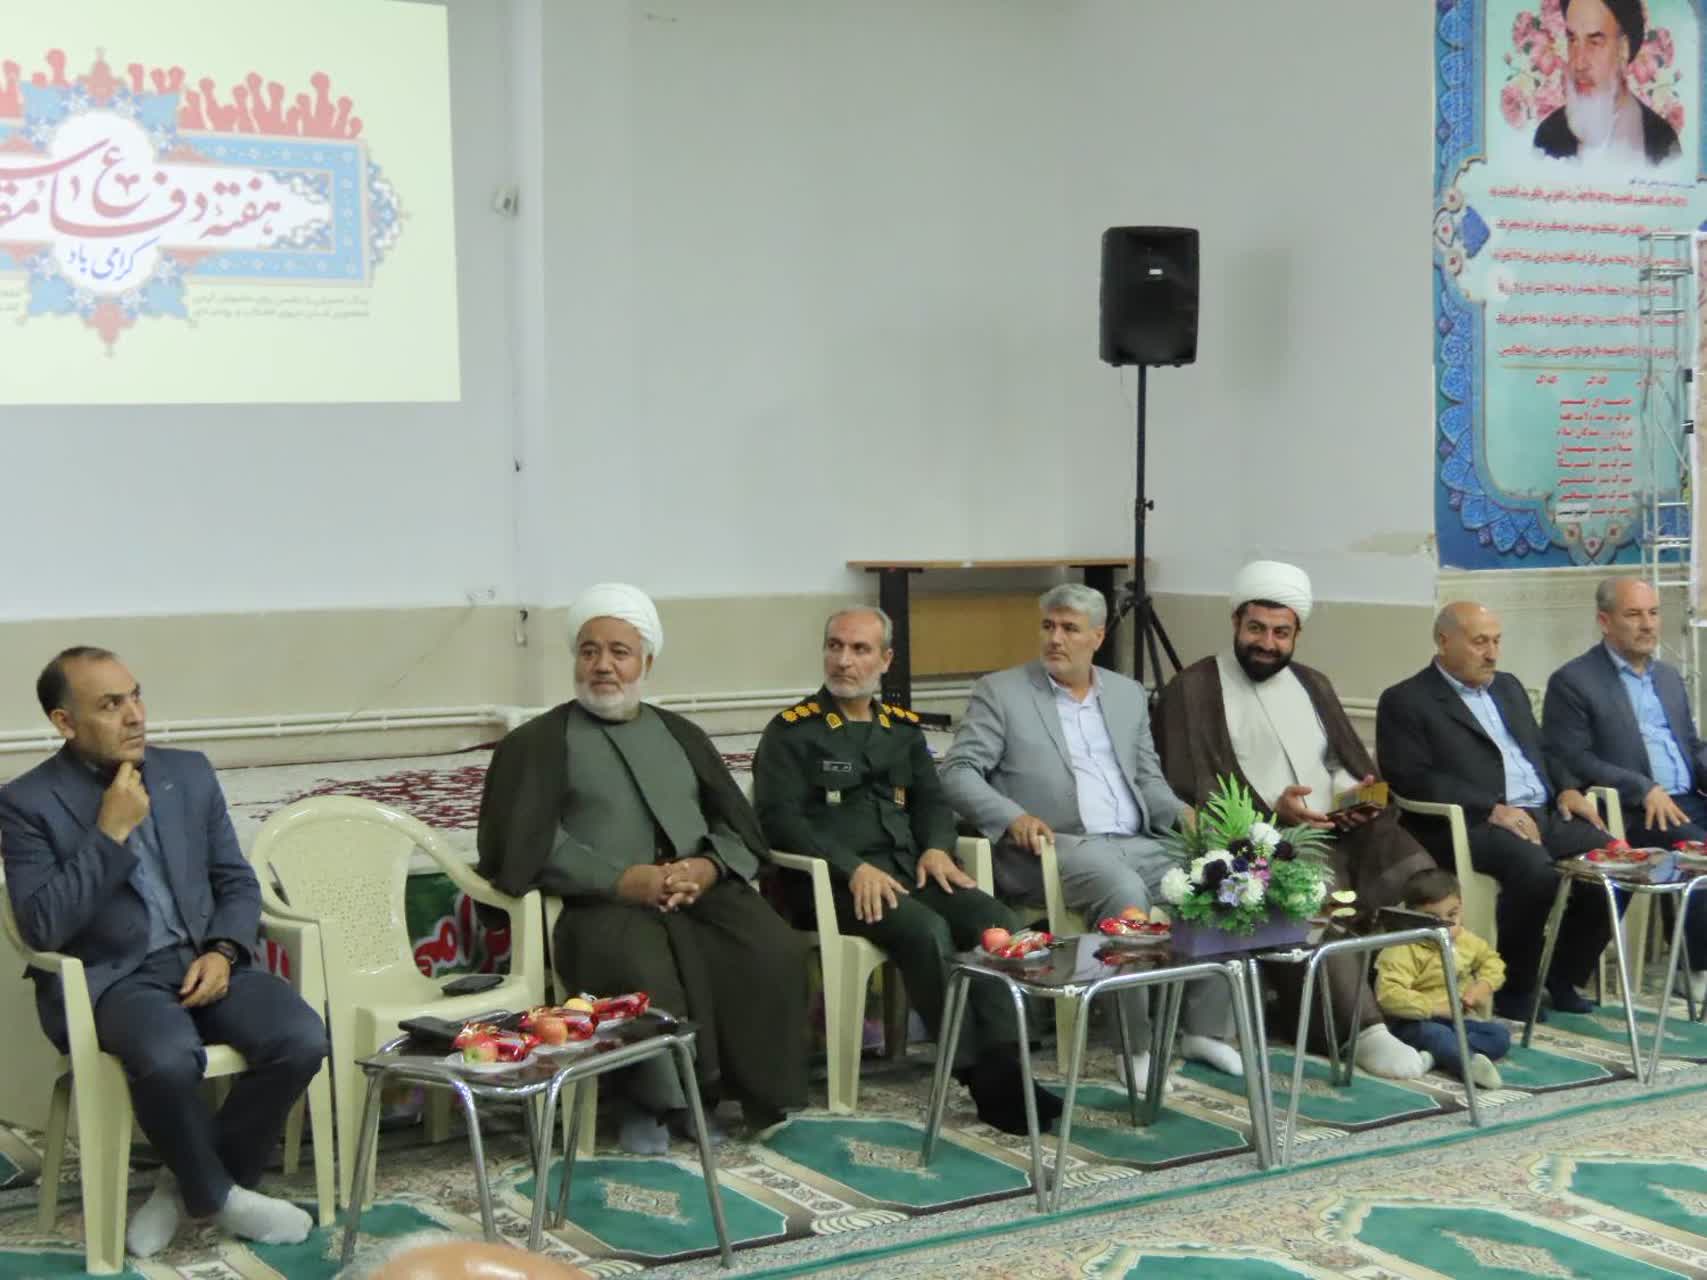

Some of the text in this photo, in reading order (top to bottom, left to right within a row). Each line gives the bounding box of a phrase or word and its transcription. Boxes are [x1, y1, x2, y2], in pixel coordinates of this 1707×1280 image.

[51, 146, 209, 238] دفاع
[198, 176, 281, 240] هفته
[67, 244, 88, 273] باد
